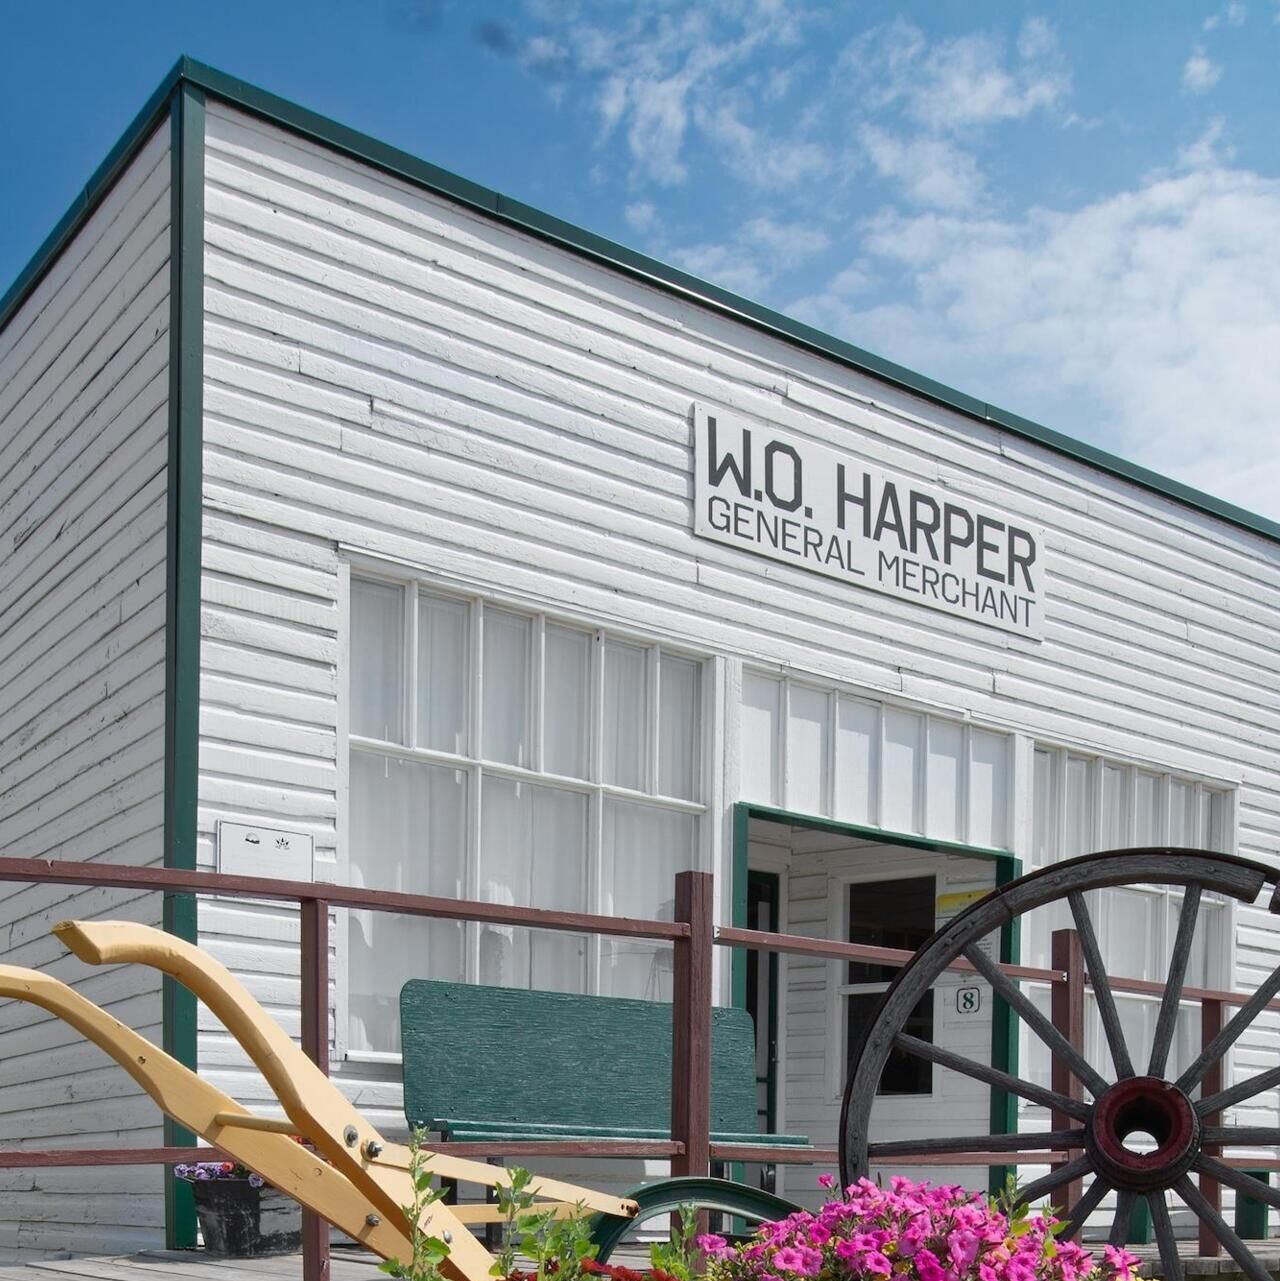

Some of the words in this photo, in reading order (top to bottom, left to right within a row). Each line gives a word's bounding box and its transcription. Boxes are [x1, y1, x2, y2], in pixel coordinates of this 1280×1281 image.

[707, 415, 814, 519] W.O.
[836, 463, 1036, 593] HARPER
[707, 495, 866, 576] GENERAL
[878, 550, 1037, 628] MERCHANT
[962, 992, 975, 1010] 8
